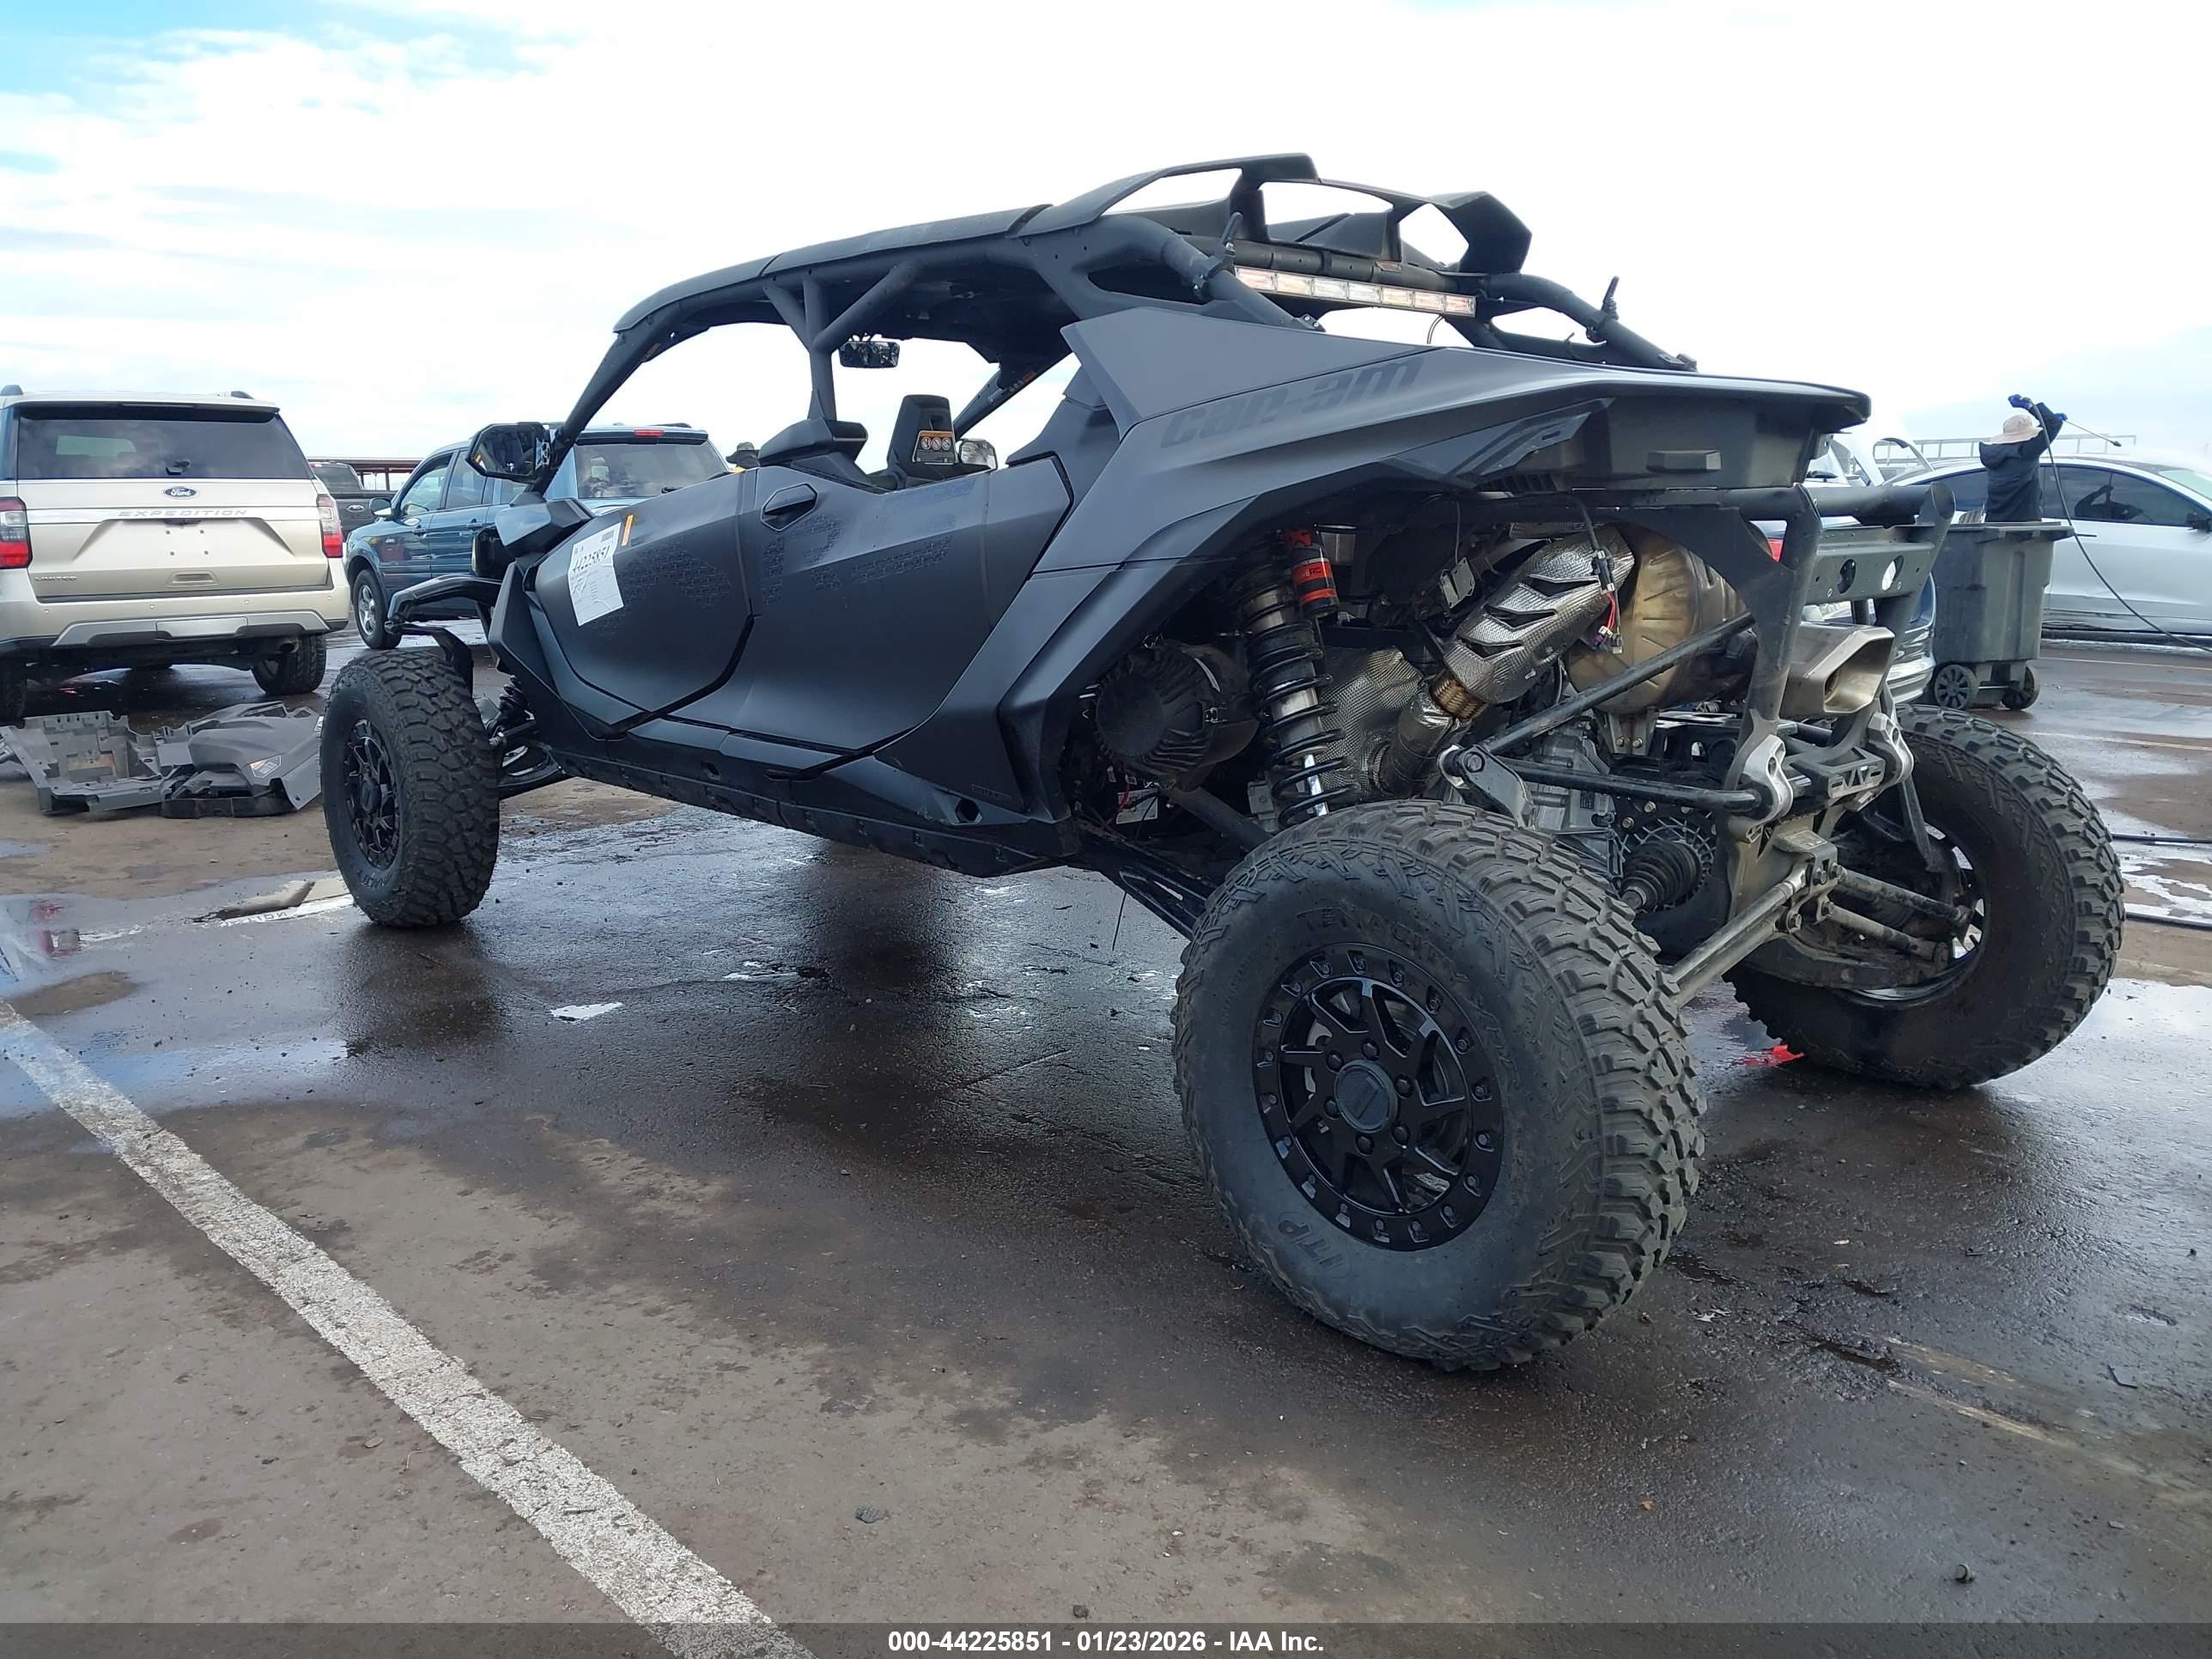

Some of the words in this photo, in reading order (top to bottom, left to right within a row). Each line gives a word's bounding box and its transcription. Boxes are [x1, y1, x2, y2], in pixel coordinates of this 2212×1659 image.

[1160, 356, 1425, 448] can-am
[170, 487, 192, 497] Ford
[1277, 1219, 1346, 1271] ITP
